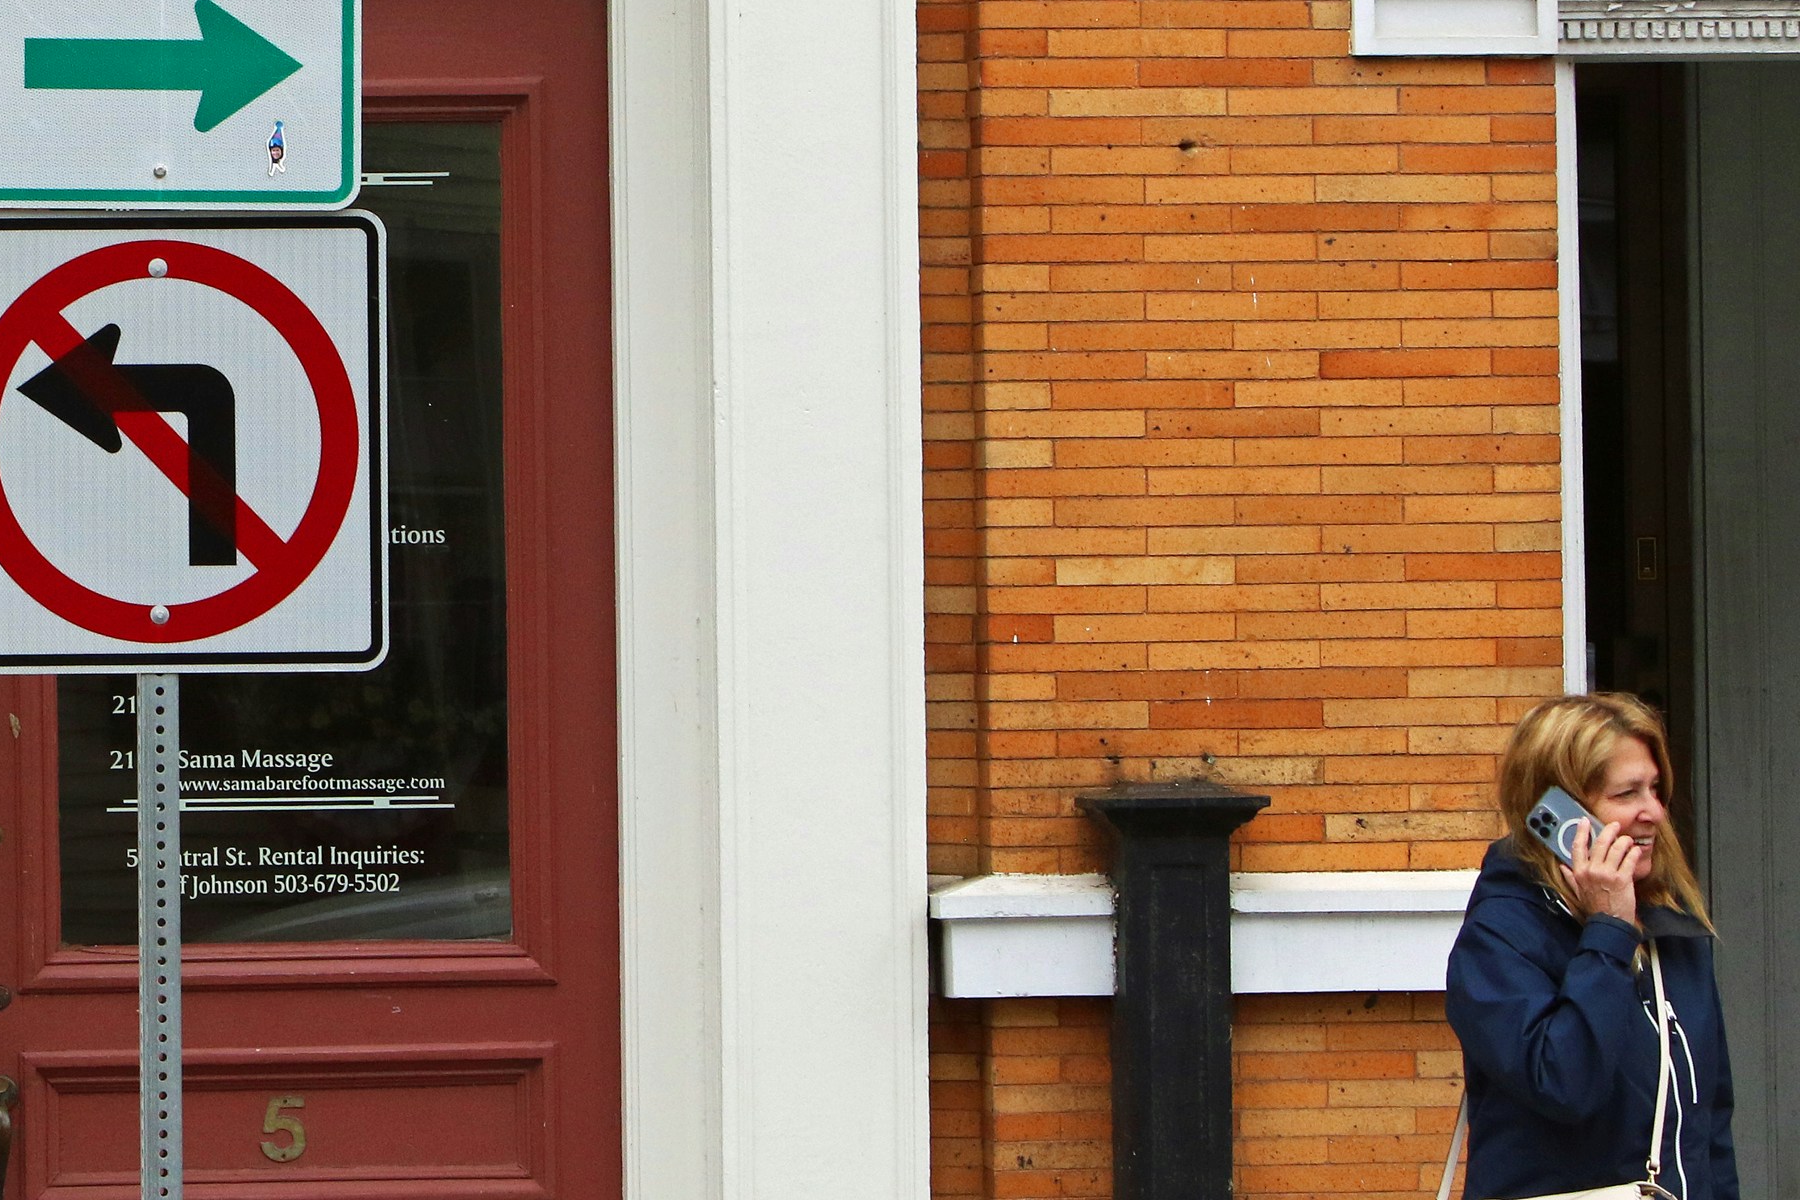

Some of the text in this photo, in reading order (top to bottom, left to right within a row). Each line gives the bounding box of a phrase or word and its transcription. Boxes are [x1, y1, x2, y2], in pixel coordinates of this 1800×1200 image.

[388, 524, 446, 544] tions
[178, 749, 236, 769] Sama
[241, 749, 334, 772] Massage
[179, 774, 446, 794] www.samabarefootmassage.com
[180, 846, 219, 867] tral
[225, 847, 253, 867] St.
[258, 845, 323, 866] Rental
[330, 844, 425, 870] Inquiries:
[189, 873, 268, 900] Johnson
[274, 873, 400, 894] 503-679-5502
[260, 1096, 306, 1162] 5
